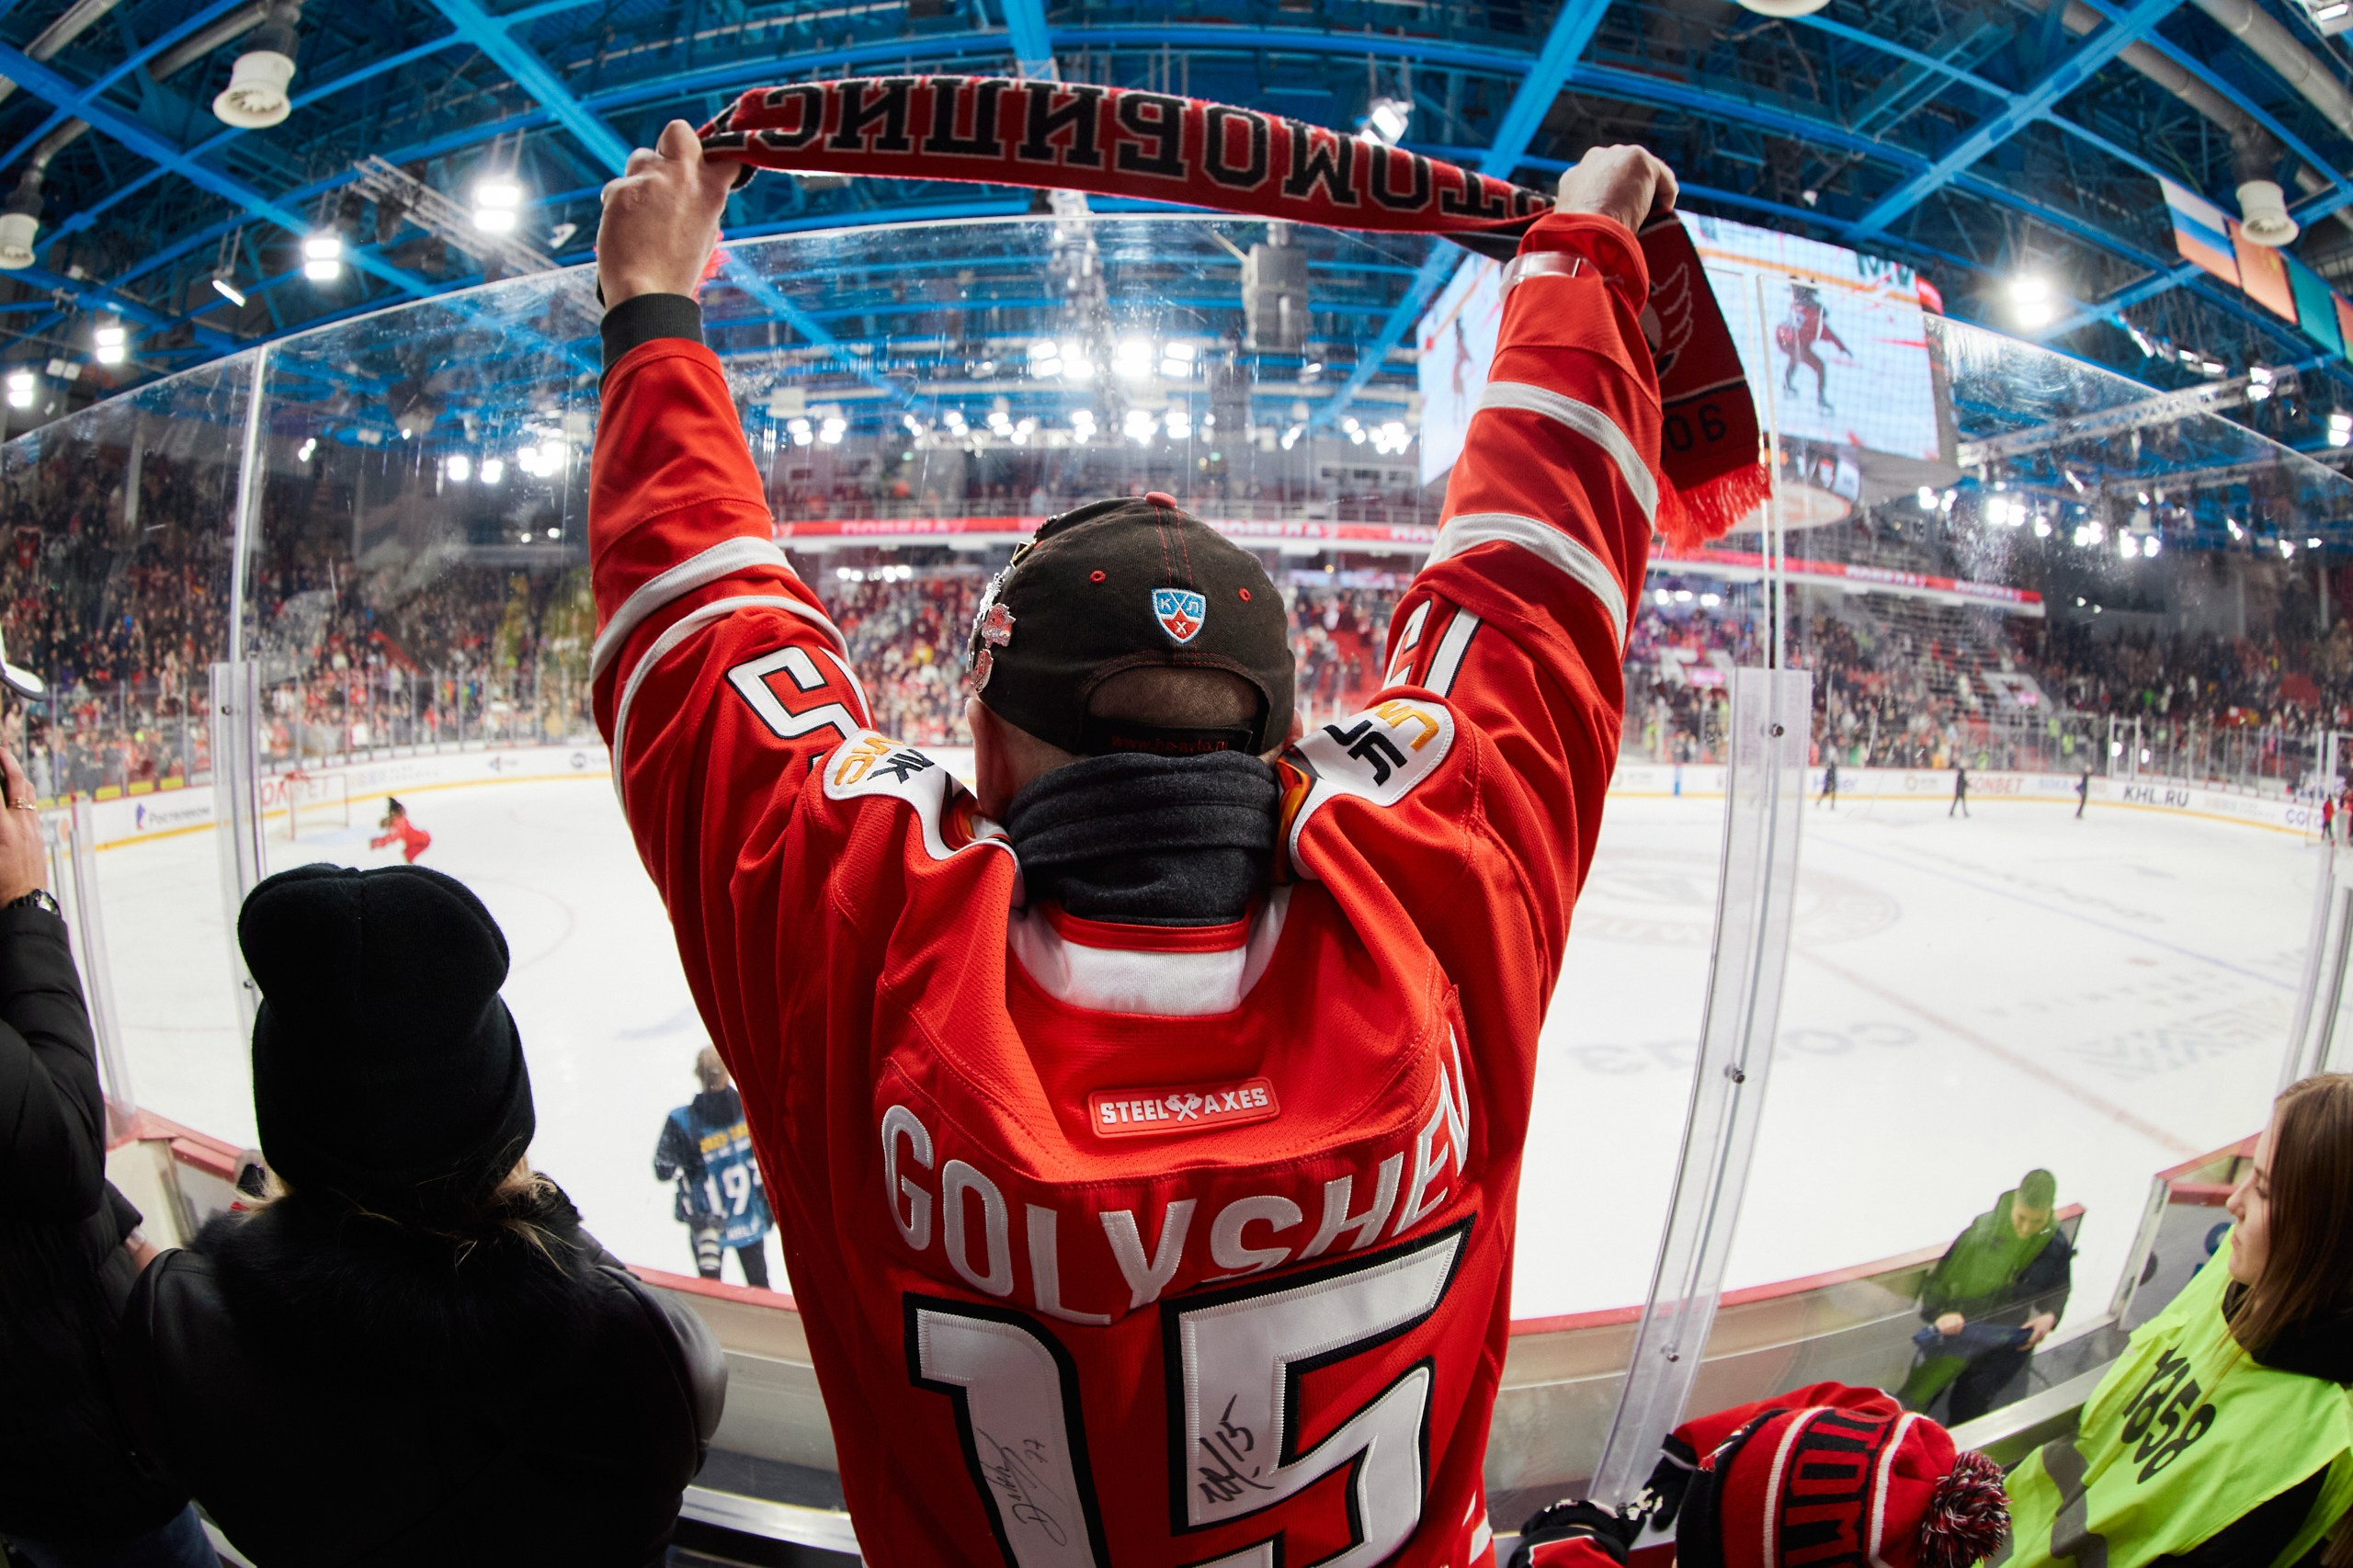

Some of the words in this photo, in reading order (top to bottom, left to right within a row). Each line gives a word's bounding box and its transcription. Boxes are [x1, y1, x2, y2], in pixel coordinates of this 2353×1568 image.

[1661, 403, 1727, 460] 06
[2123, 785, 2189, 808] KHL.RU
[1100, 1098, 1170, 1124] STEEL
[1204, 1087, 1268, 1115] AXES
[881, 1022, 1470, 1325] GOLYSHEV
[903, 1218, 1476, 1568] 15
[2122, 1343, 2216, 1485] 1858
